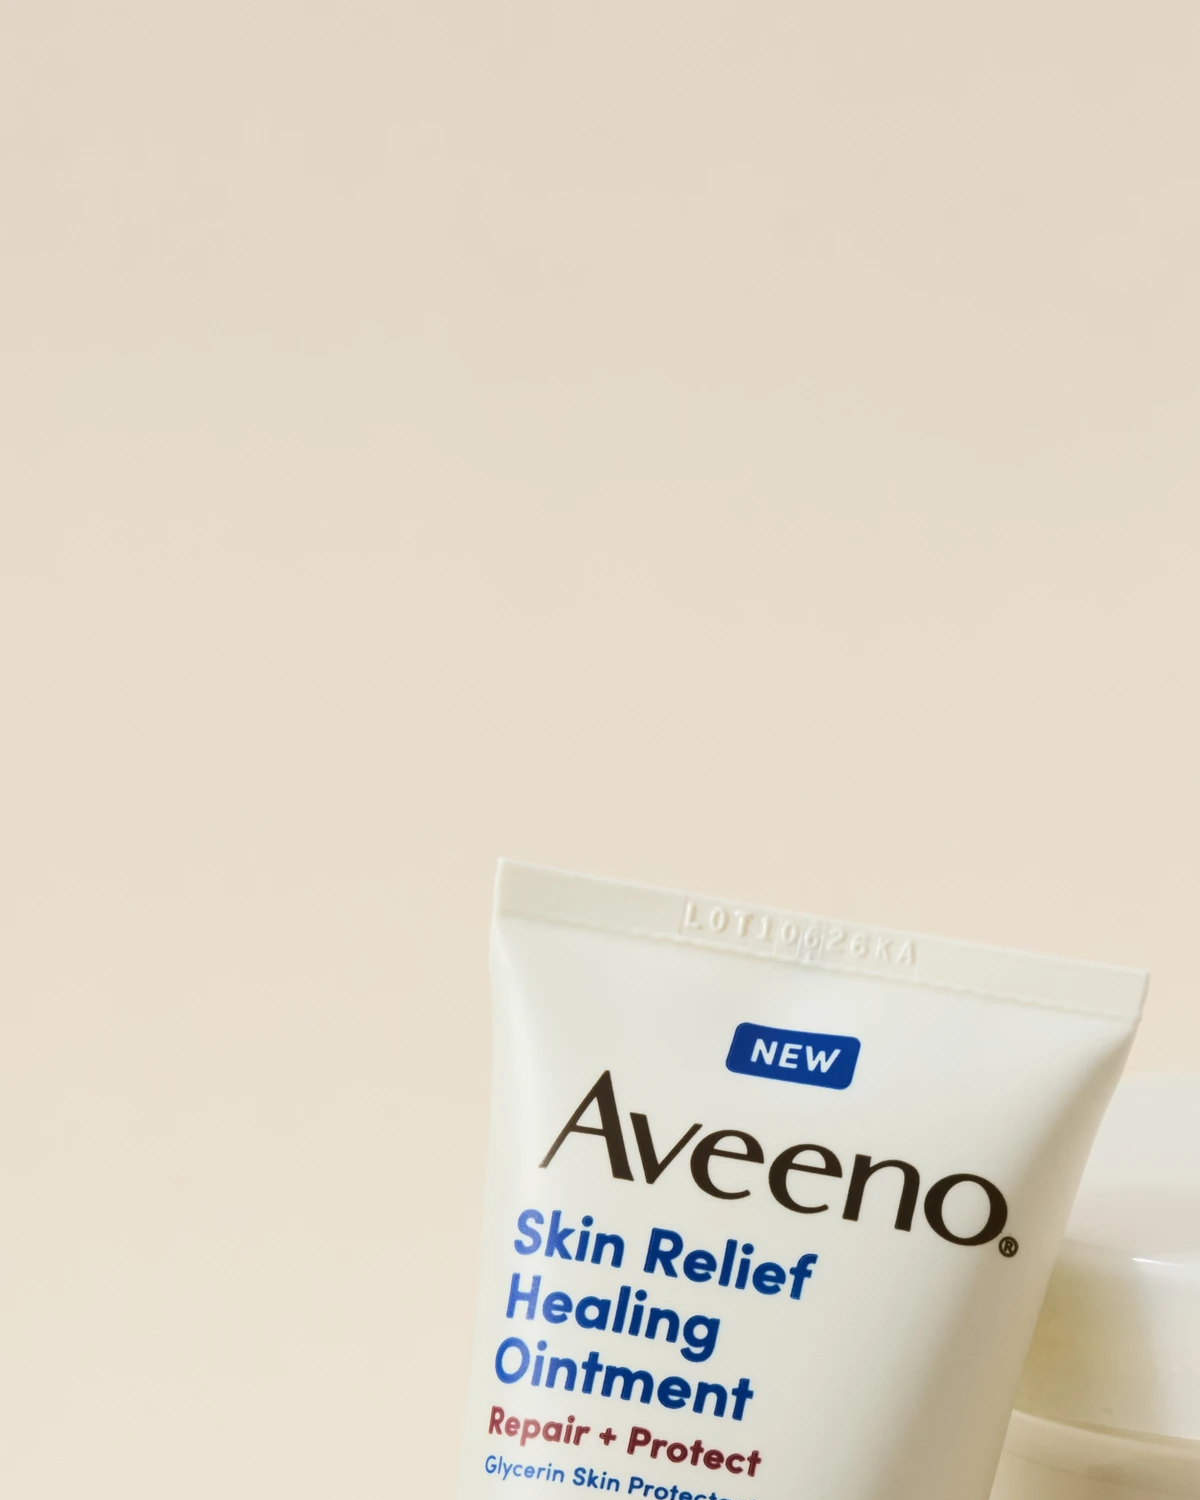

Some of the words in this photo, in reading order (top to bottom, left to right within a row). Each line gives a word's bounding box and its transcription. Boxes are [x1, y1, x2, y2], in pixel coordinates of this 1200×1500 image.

[750, 1038, 841, 1073] NEW
[513, 1208, 625, 1269] Skin
[644, 1227, 818, 1300] Relief
[506, 1272, 720, 1363] Healing
[495, 1336, 754, 1421] Ointment
[484, 1455, 565, 1487] Glycerin
[572, 1467, 620, 1494] Skin
[488, 1405, 589, 1446] Repair
[598, 1428, 616, 1446] +
[627, 1426, 762, 1477] Protect
